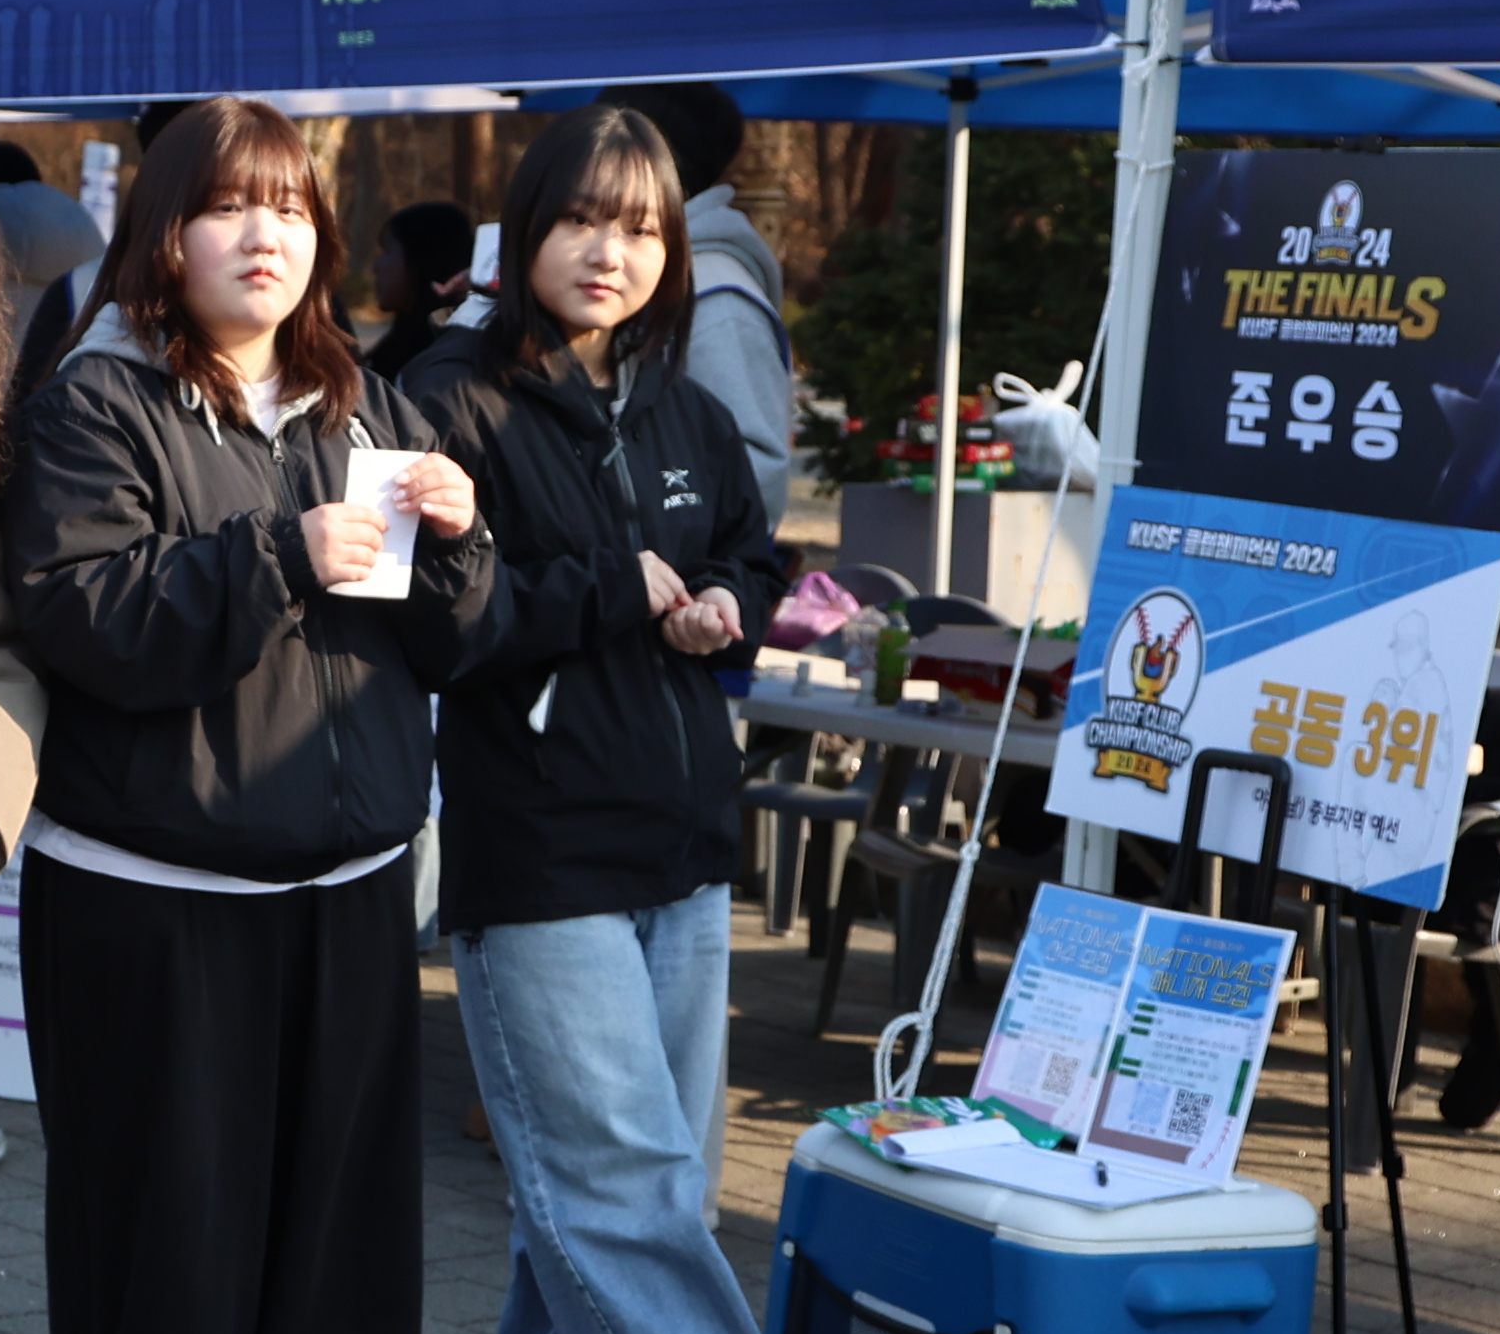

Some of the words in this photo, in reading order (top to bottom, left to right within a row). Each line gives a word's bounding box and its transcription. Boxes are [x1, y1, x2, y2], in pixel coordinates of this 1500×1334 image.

[1221, 269, 1294, 329] THE
[1292, 272, 1447, 340] FINALS
[1354, 324, 1399, 348] 2024
[1226, 370, 1402, 461] 준우승
[1127, 520, 1182, 553] KUSF
[1281, 541, 1338, 577] 2024
[1108, 698, 1145, 724] KUSF
[1251, 680, 1347, 768] 공동
[1355, 701, 1439, 788] 3위
[1088, 719, 1192, 766] CHAMPIONSHIP
[1309, 799, 1366, 833] 중부지역
[1139, 943, 1276, 988] NATIONALS
[1210, 982, 1252, 1010] 모집
